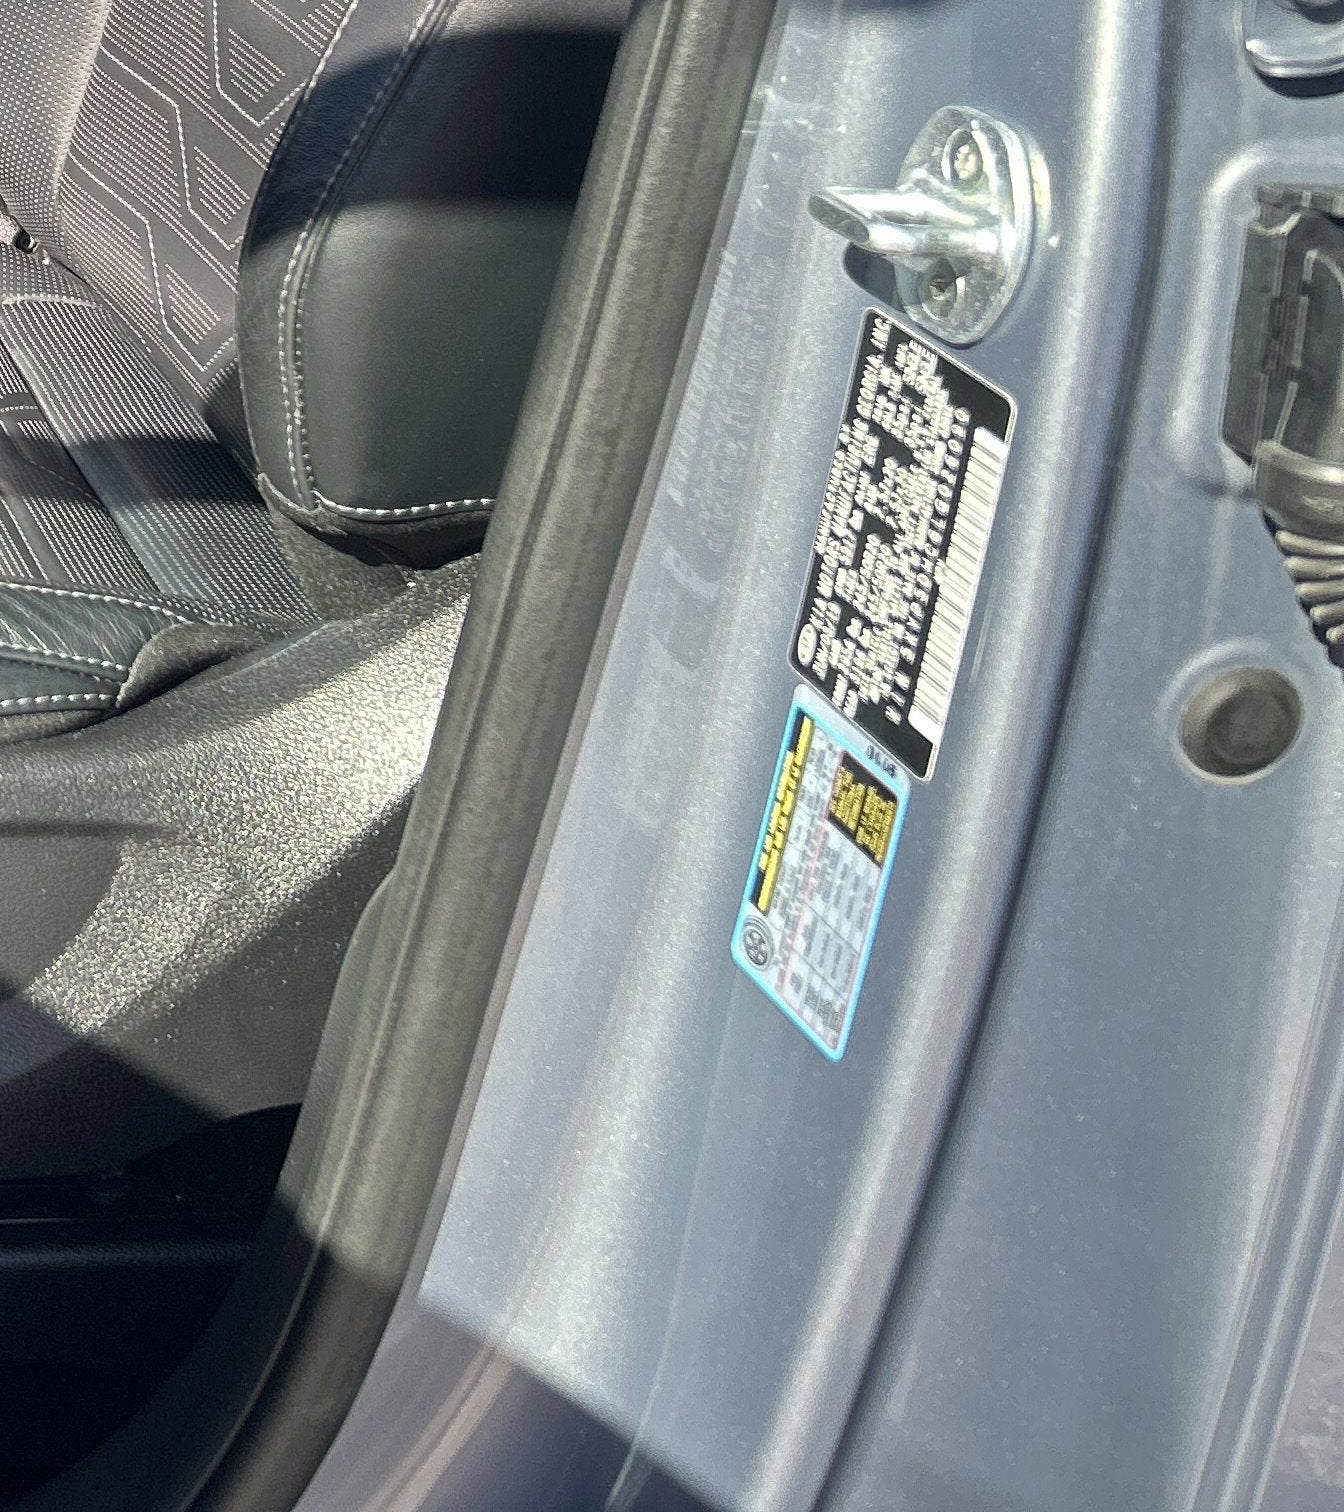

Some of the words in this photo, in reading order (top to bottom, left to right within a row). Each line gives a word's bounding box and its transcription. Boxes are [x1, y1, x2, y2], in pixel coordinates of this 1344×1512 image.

[901, 338, 923, 387] SINGLE
[813, 445, 846, 556] MANUFACTURED
[828, 415, 869, 540] MANUFACTURING
[815, 533, 843, 601] MOTORS
[808, 592, 828, 632] KIA
[883, 665, 911, 728] VIN
